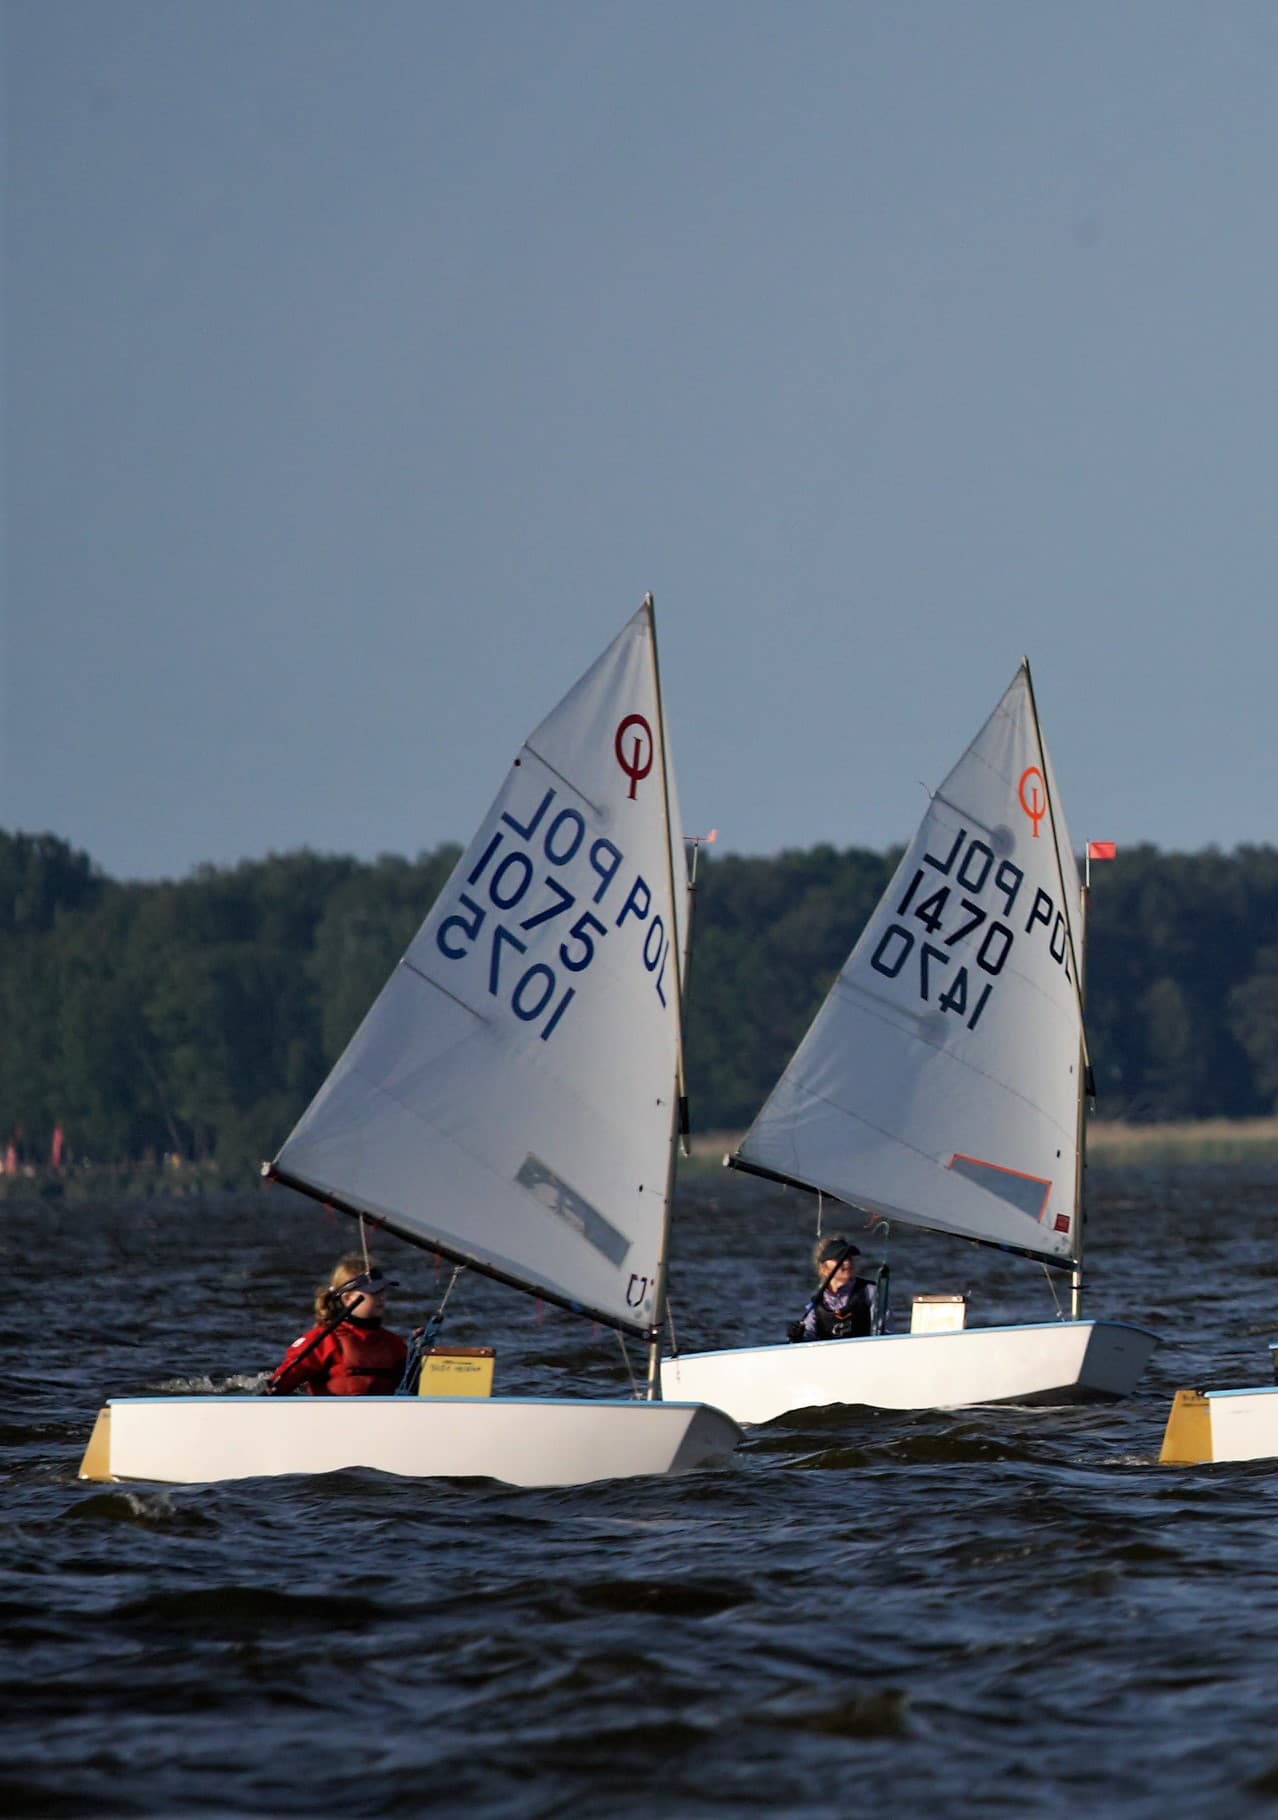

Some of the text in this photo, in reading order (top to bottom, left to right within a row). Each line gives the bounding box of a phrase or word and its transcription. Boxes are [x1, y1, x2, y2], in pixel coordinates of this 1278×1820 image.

[467, 832, 608, 972] 1075
[615, 875, 670, 1009] POL
[897, 869, 1014, 976] 1470
